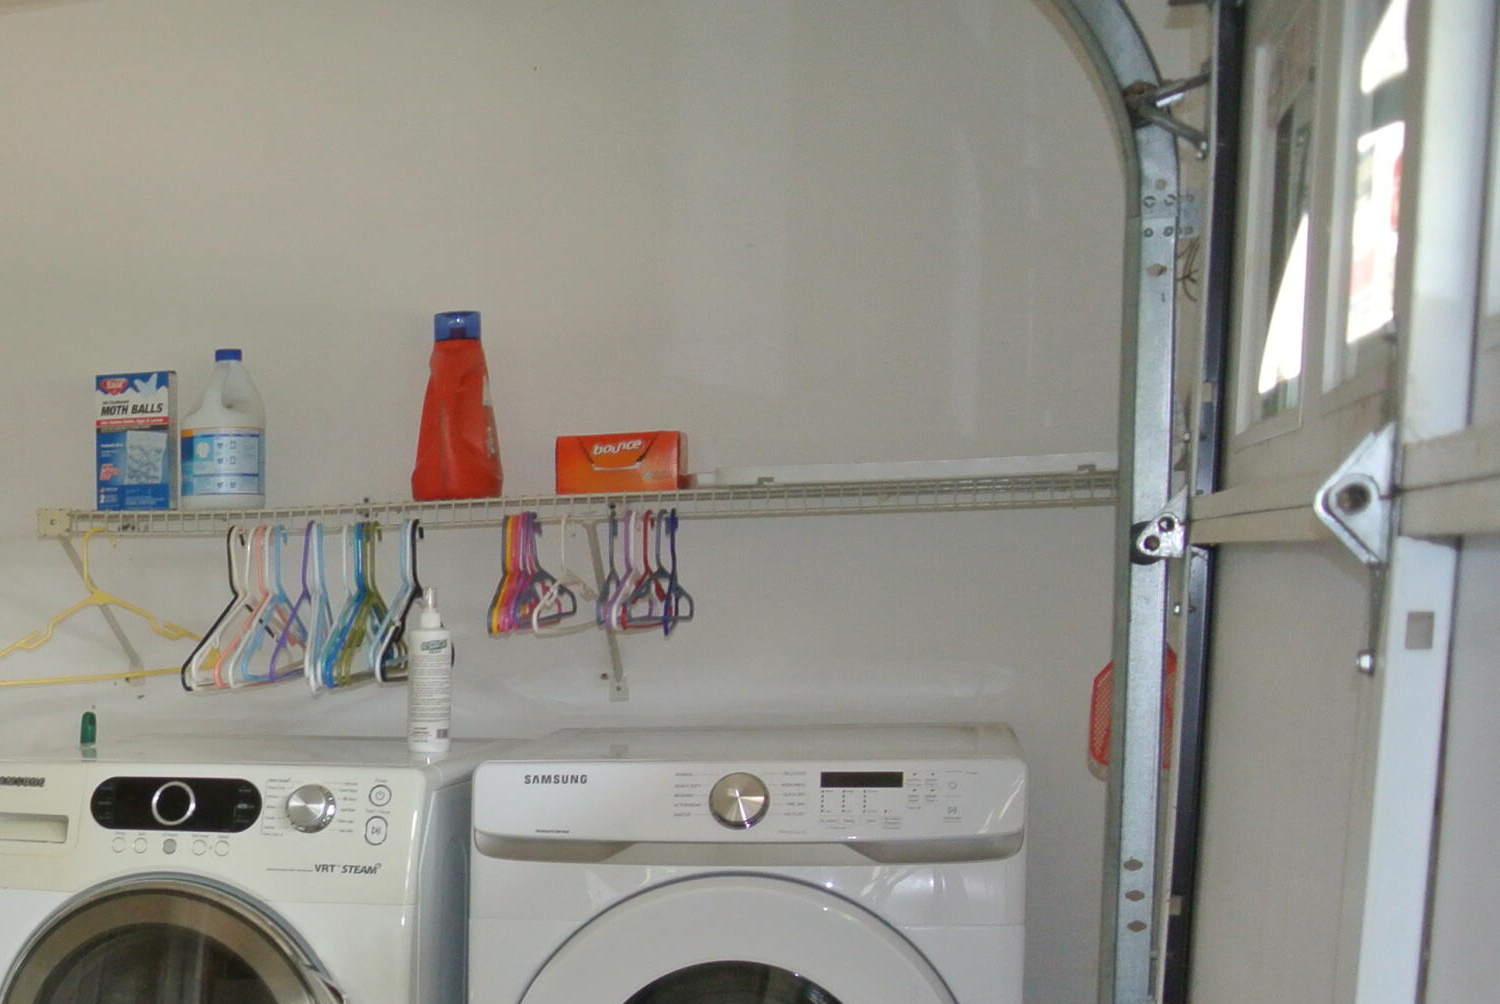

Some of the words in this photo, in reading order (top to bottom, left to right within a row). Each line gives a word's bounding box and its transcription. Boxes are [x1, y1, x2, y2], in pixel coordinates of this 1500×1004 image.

[101, 404, 129, 416] MOTH
[131, 403, 164, 415] BALLS
[593, 439, 644, 455] bounce
[524, 774, 588, 785] SAMSUNG
[315, 864, 335, 873] VRT
[341, 864, 379, 875] STEAM
